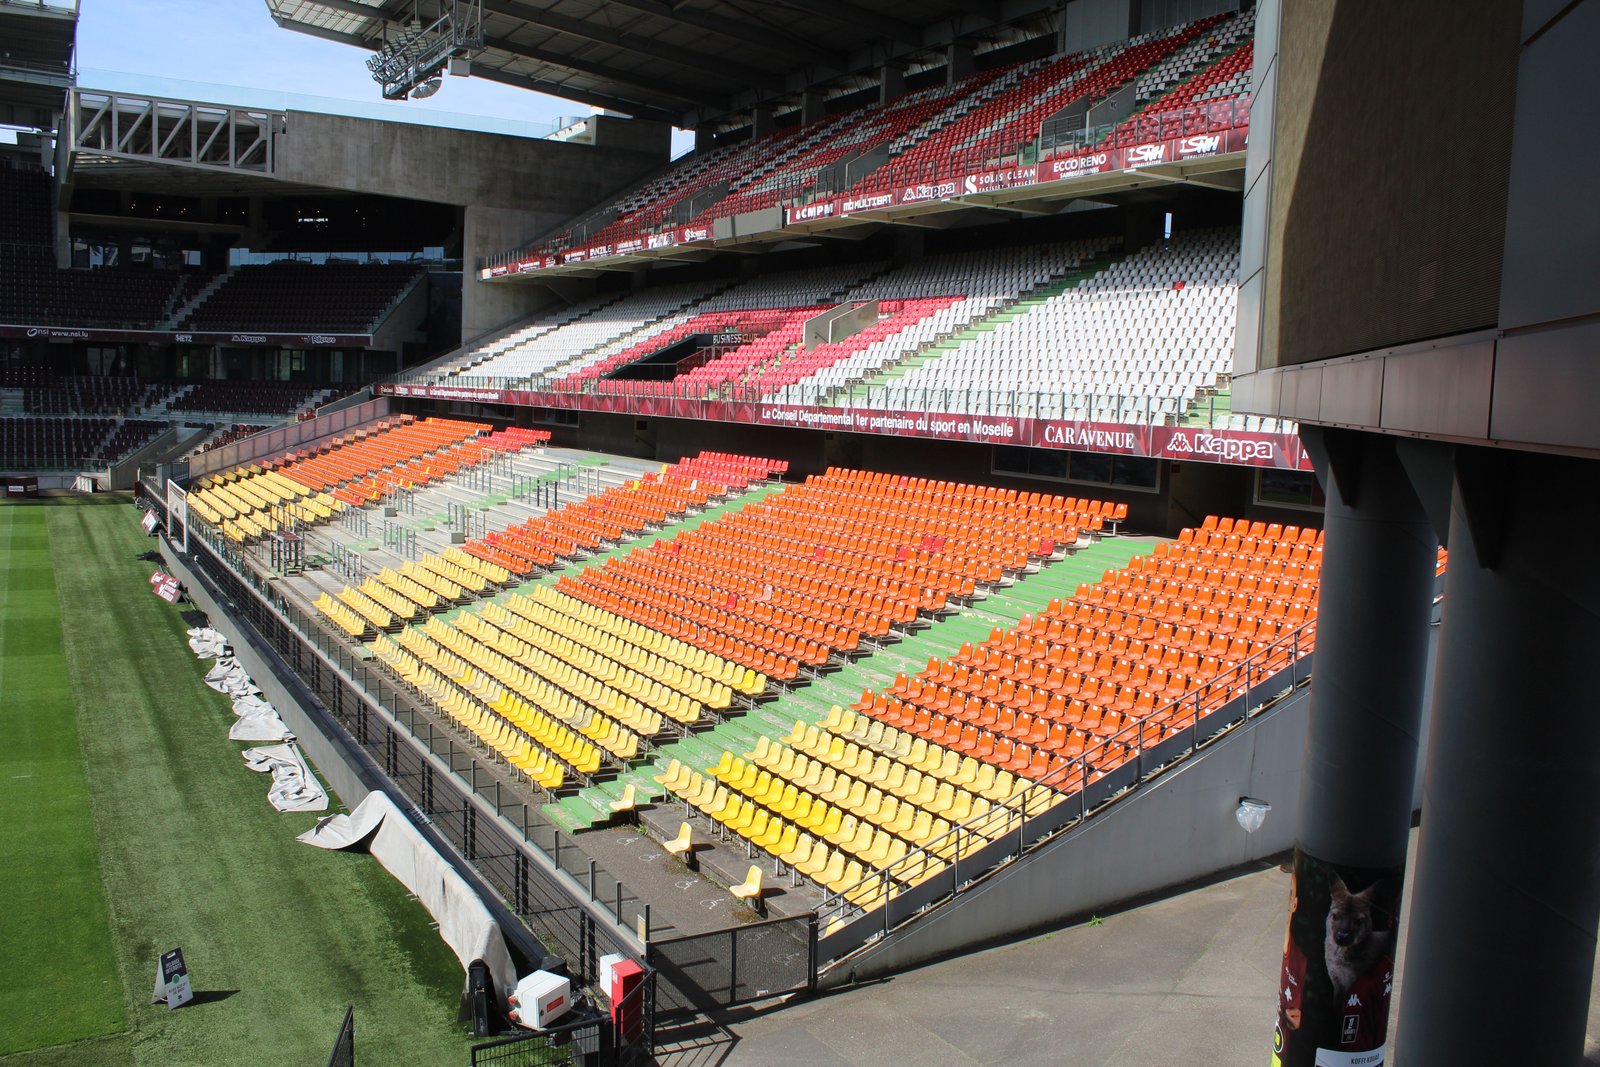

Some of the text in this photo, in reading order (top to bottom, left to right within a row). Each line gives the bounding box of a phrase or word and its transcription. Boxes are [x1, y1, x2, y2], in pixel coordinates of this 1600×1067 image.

[1053, 153, 1107, 173] ECCO RENO
[979, 167, 1036, 185] SOLIS CLEAN
[916, 183, 955, 199] Kappa
[854, 194, 893, 209] MULTIBAT
[713, 334, 741, 344] BUSINESS
[762, 407, 1014, 437] Le Conseil Départemental 1er partenaire du sport en Moselle
[1044, 425, 1134, 448] CAR AVENUE
[1193, 433, 1274, 460] Kappa
